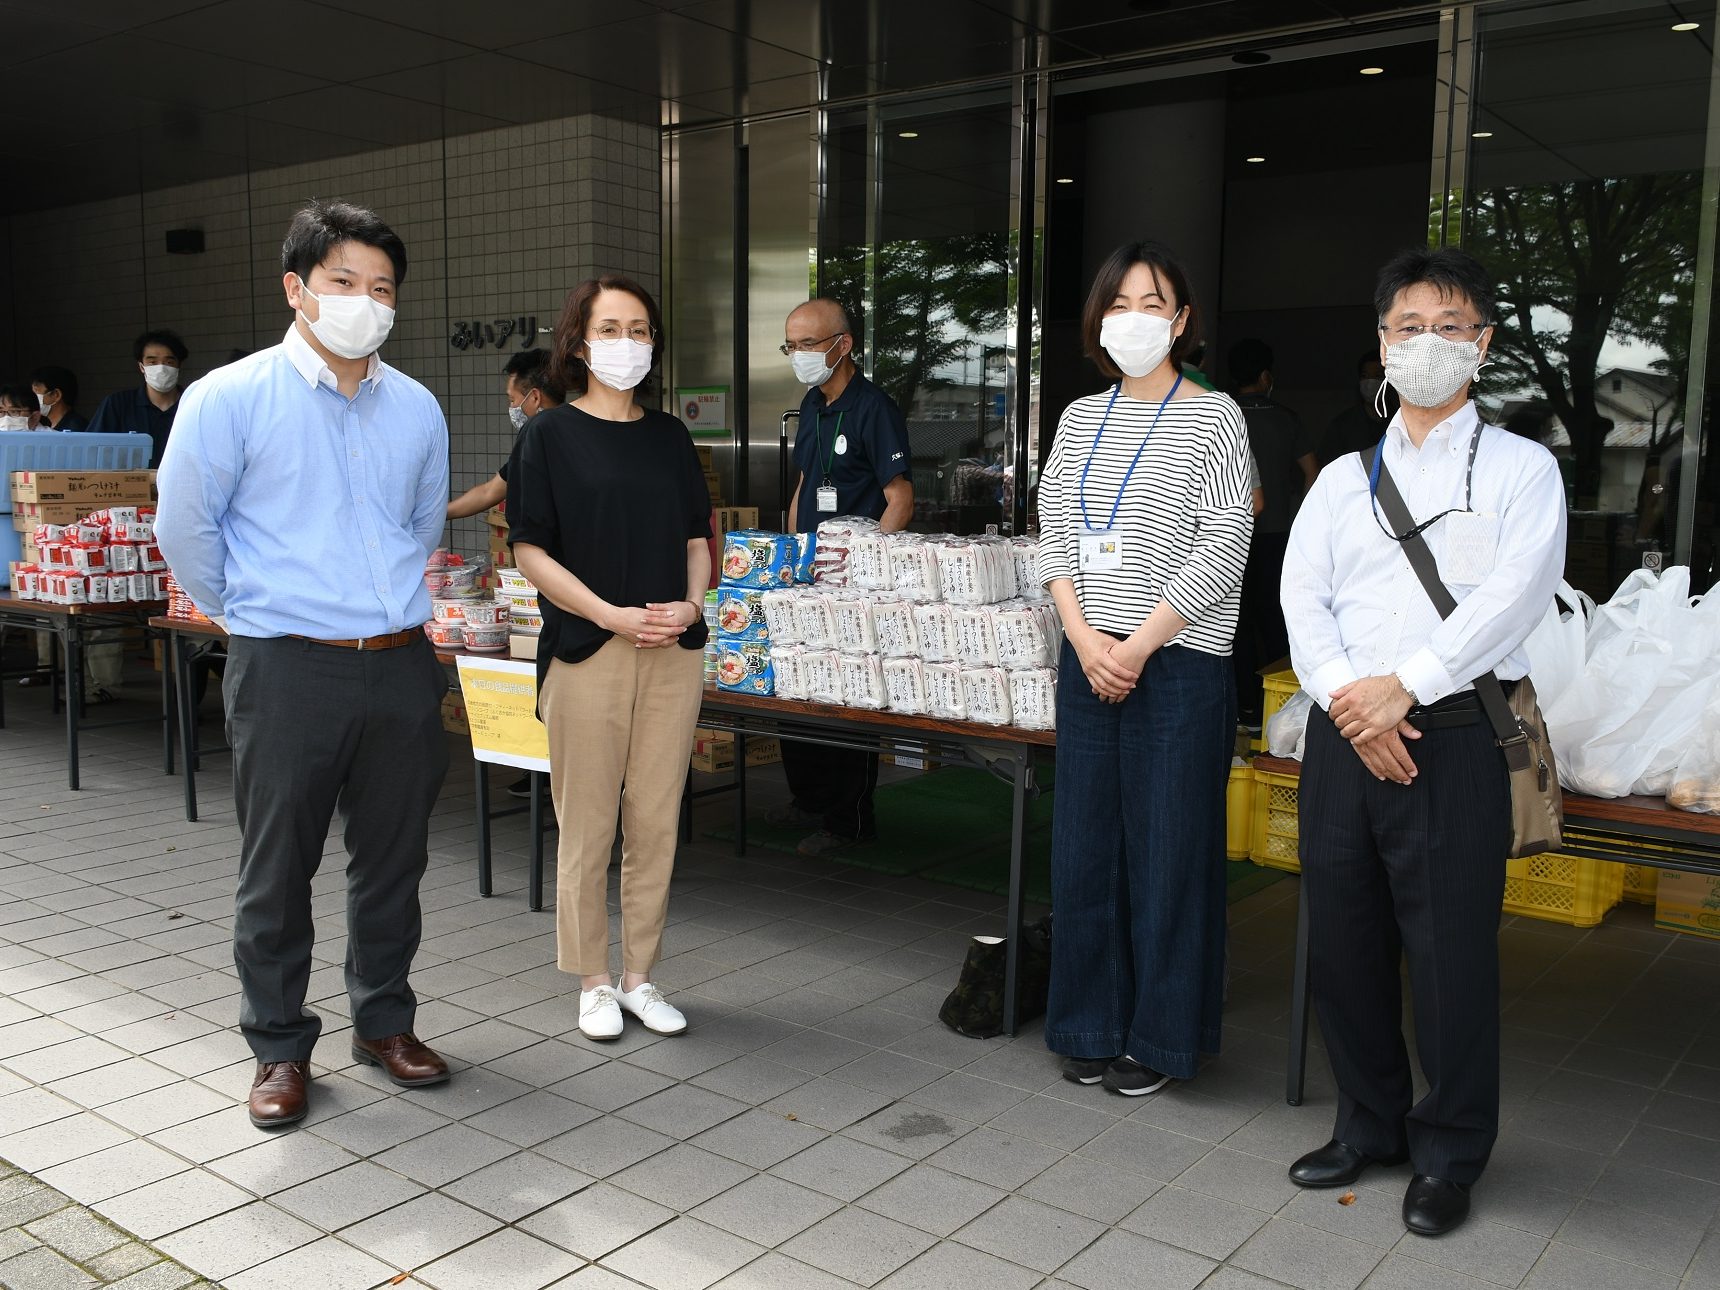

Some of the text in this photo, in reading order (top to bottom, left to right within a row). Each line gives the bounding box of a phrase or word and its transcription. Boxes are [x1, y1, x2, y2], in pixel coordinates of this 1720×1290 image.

[948, 558, 956, 593] しょうゆ
[1020, 554, 1030, 590] しょうゆ
[920, 618, 932, 650] しょうゆ
[954, 620, 962, 655] ラーメン
[962, 618, 970, 655] しょうゆ
[1006, 620, 1017, 656] しょうゆ
[970, 678, 982, 712] しょうゆ
